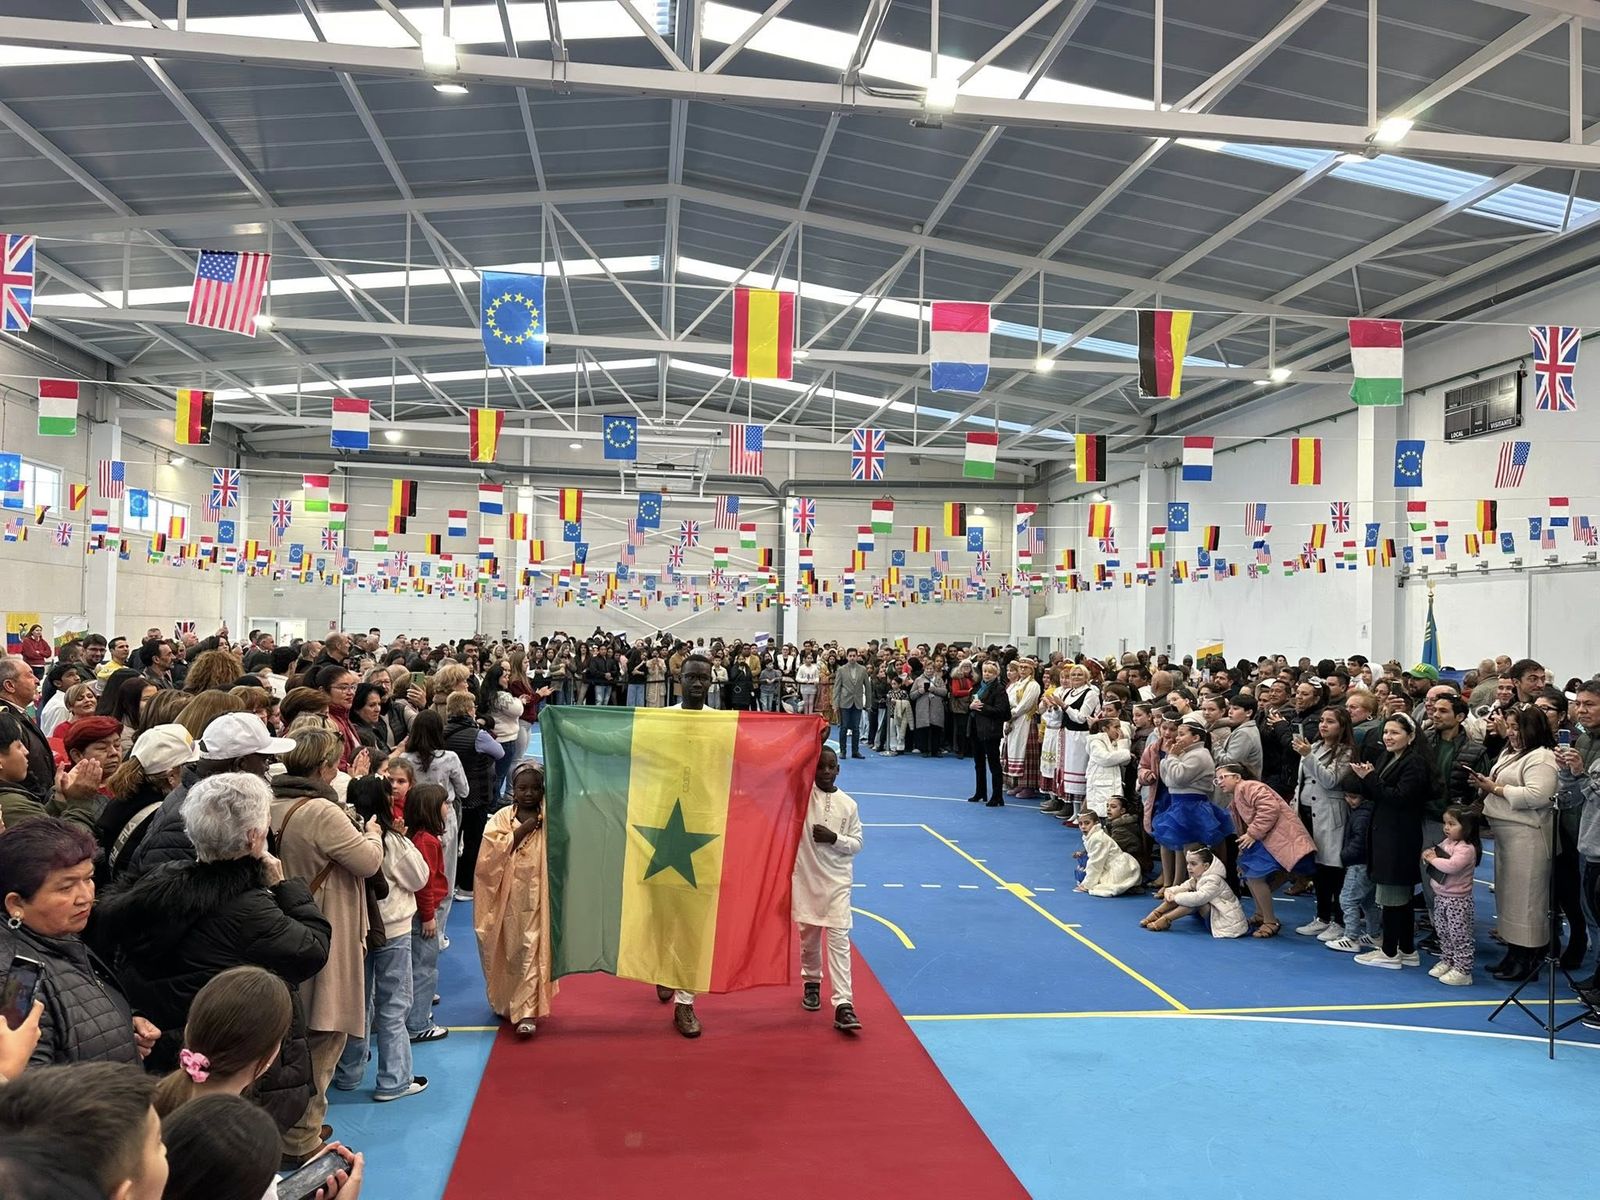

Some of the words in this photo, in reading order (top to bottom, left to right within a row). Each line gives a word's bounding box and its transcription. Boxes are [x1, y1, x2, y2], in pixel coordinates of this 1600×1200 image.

[1490, 418, 1513, 429] VISITANTE
[1450, 430, 1464, 439] LOCAL
[118, 822, 137, 845] FILA
